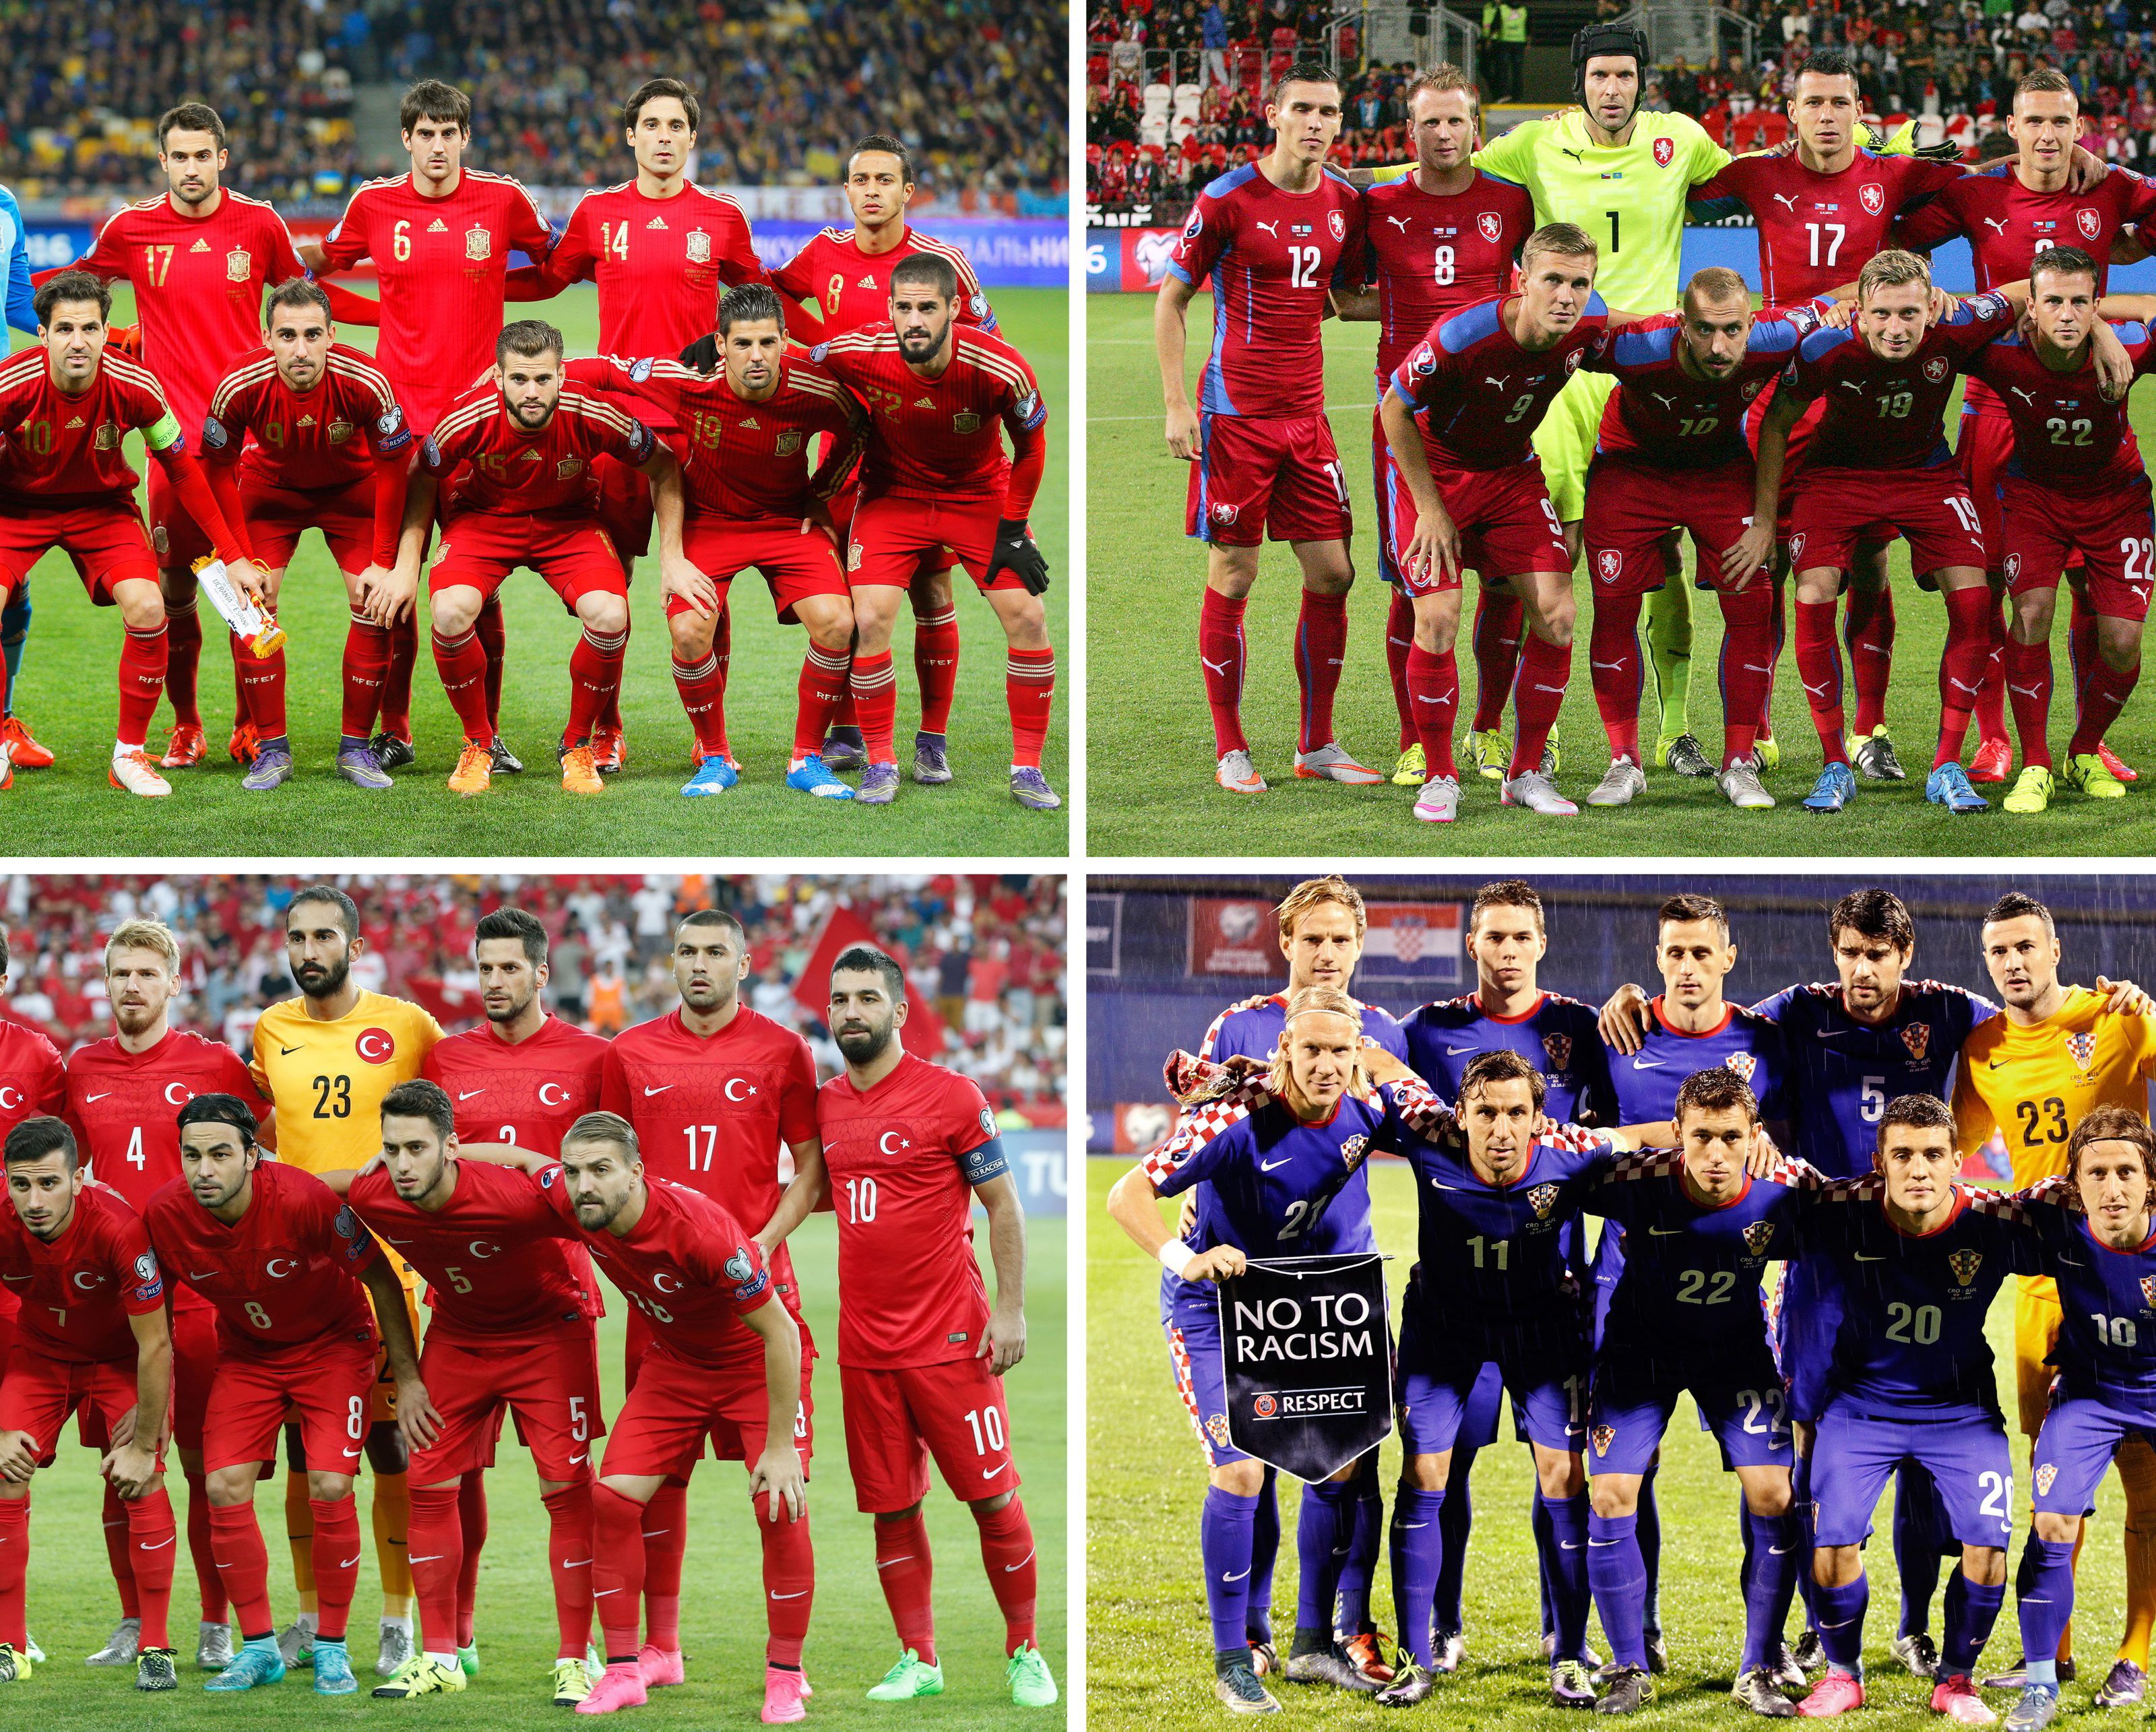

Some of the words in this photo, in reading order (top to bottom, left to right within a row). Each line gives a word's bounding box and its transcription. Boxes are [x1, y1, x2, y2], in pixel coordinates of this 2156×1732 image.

[393, 220, 411, 261] 6
[600, 220, 629, 262] 14
[1606, 211, 1619, 253] 1
[1804, 222, 1846, 267] 17
[144, 245, 175, 287] 17
[1288, 245, 1321, 288] 12
[1434, 245, 1455, 286] 8
[826, 274, 844, 315] 8
[857, 281, 878, 290] adidas
[866, 385, 902, 424] 22
[1504, 393, 1534, 423] 9
[1875, 391, 1914, 418] 19
[21, 419, 51, 455] 10
[265, 422, 284, 449] 9
[389, 430, 412, 446] RESPECT
[693, 411, 722, 449] 19
[738, 420, 761, 430] adidas
[1677, 417, 1719, 437] 10
[2046, 418, 2094, 446] 22
[474, 452, 506, 480] 15
[1540, 498, 1563, 536] 9
[1942, 496, 1983, 534] 19
[2120, 537, 2155, 581] 22
[245, 674, 277, 684] RFEF
[923, 658, 954, 666] RFEF
[352, 675, 384, 687] RFEF
[443, 676, 477, 691] RFEF
[687, 702, 714, 714] RFEF
[312, 1075, 351, 1119] 23
[1860, 1075, 1885, 1122] 5
[2016, 1097, 2069, 1147] 23
[126, 1126, 146, 1171] 4
[683, 1124, 718, 1172] 17
[980, 1159, 1003, 1175] RACISM
[845, 1177, 877, 1225] 10
[1277, 1194, 1329, 1240] 21
[1467, 1236, 1509, 1271] 11
[444, 1266, 473, 1294] 5
[1676, 1269, 1736, 1305] 22
[49, 1307, 66, 1327] 7
[244, 1302, 272, 1329] 8
[1234, 1297, 1302, 1330] NO
[1311, 1293, 1370, 1328] TO
[1886, 1302, 1942, 1345] 20
[2091, 1313, 2137, 1347] 10
[1236, 1330, 1374, 1363] RACISM
[347, 1395, 363, 1440] 8
[569, 1396, 588, 1442] 5
[1283, 1392, 1366, 1413] RESPECT
[1736, 1388, 1791, 1434] 22
[963, 1405, 1005, 1456] 10
